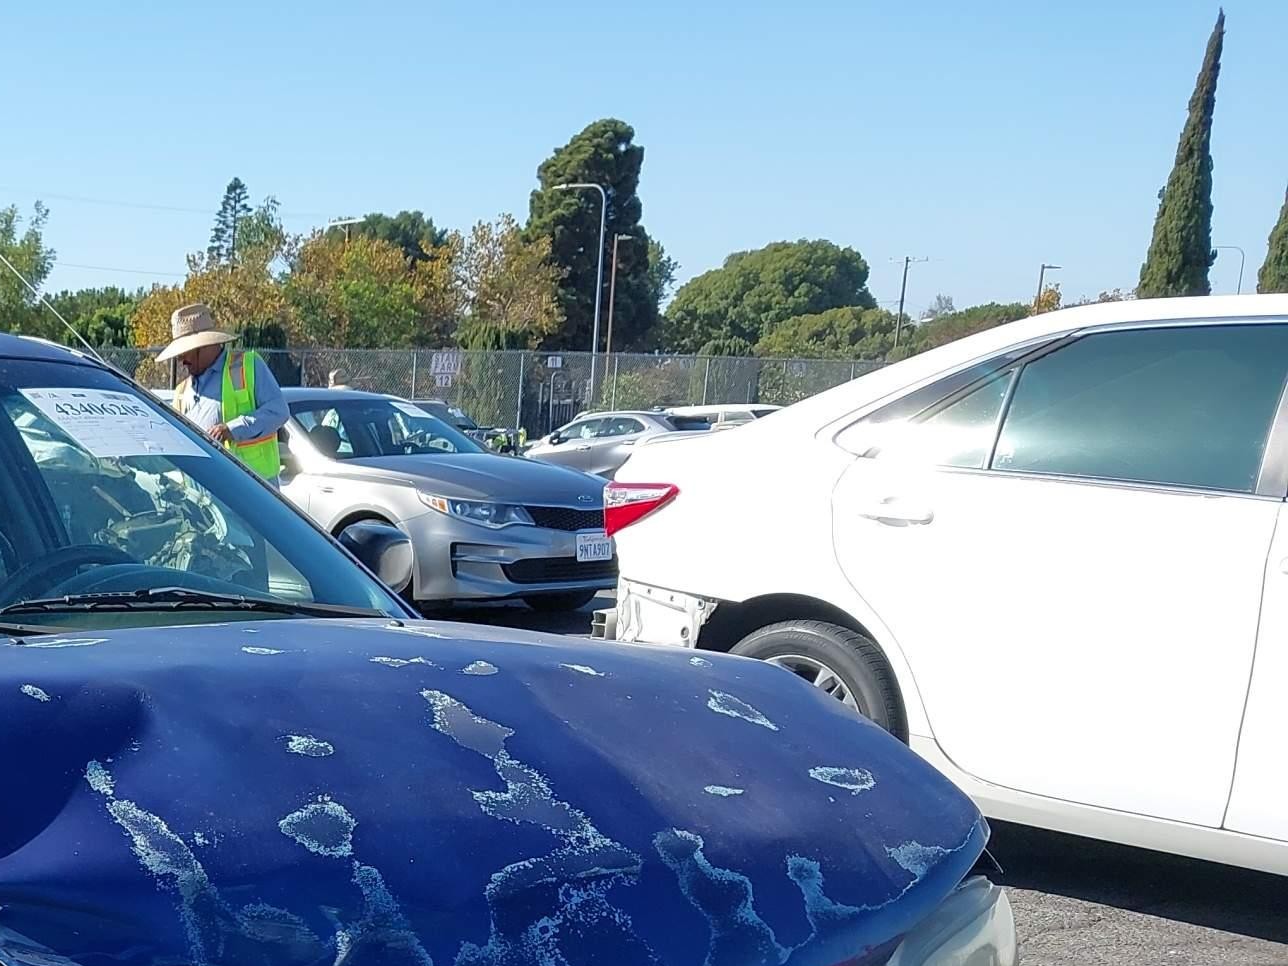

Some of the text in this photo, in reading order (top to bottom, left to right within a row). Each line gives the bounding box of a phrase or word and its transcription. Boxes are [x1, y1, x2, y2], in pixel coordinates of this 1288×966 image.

[439, 375, 450, 386] 12
[55, 402, 150, 418] 43406205
[579, 543, 610, 558] 9NTA907
